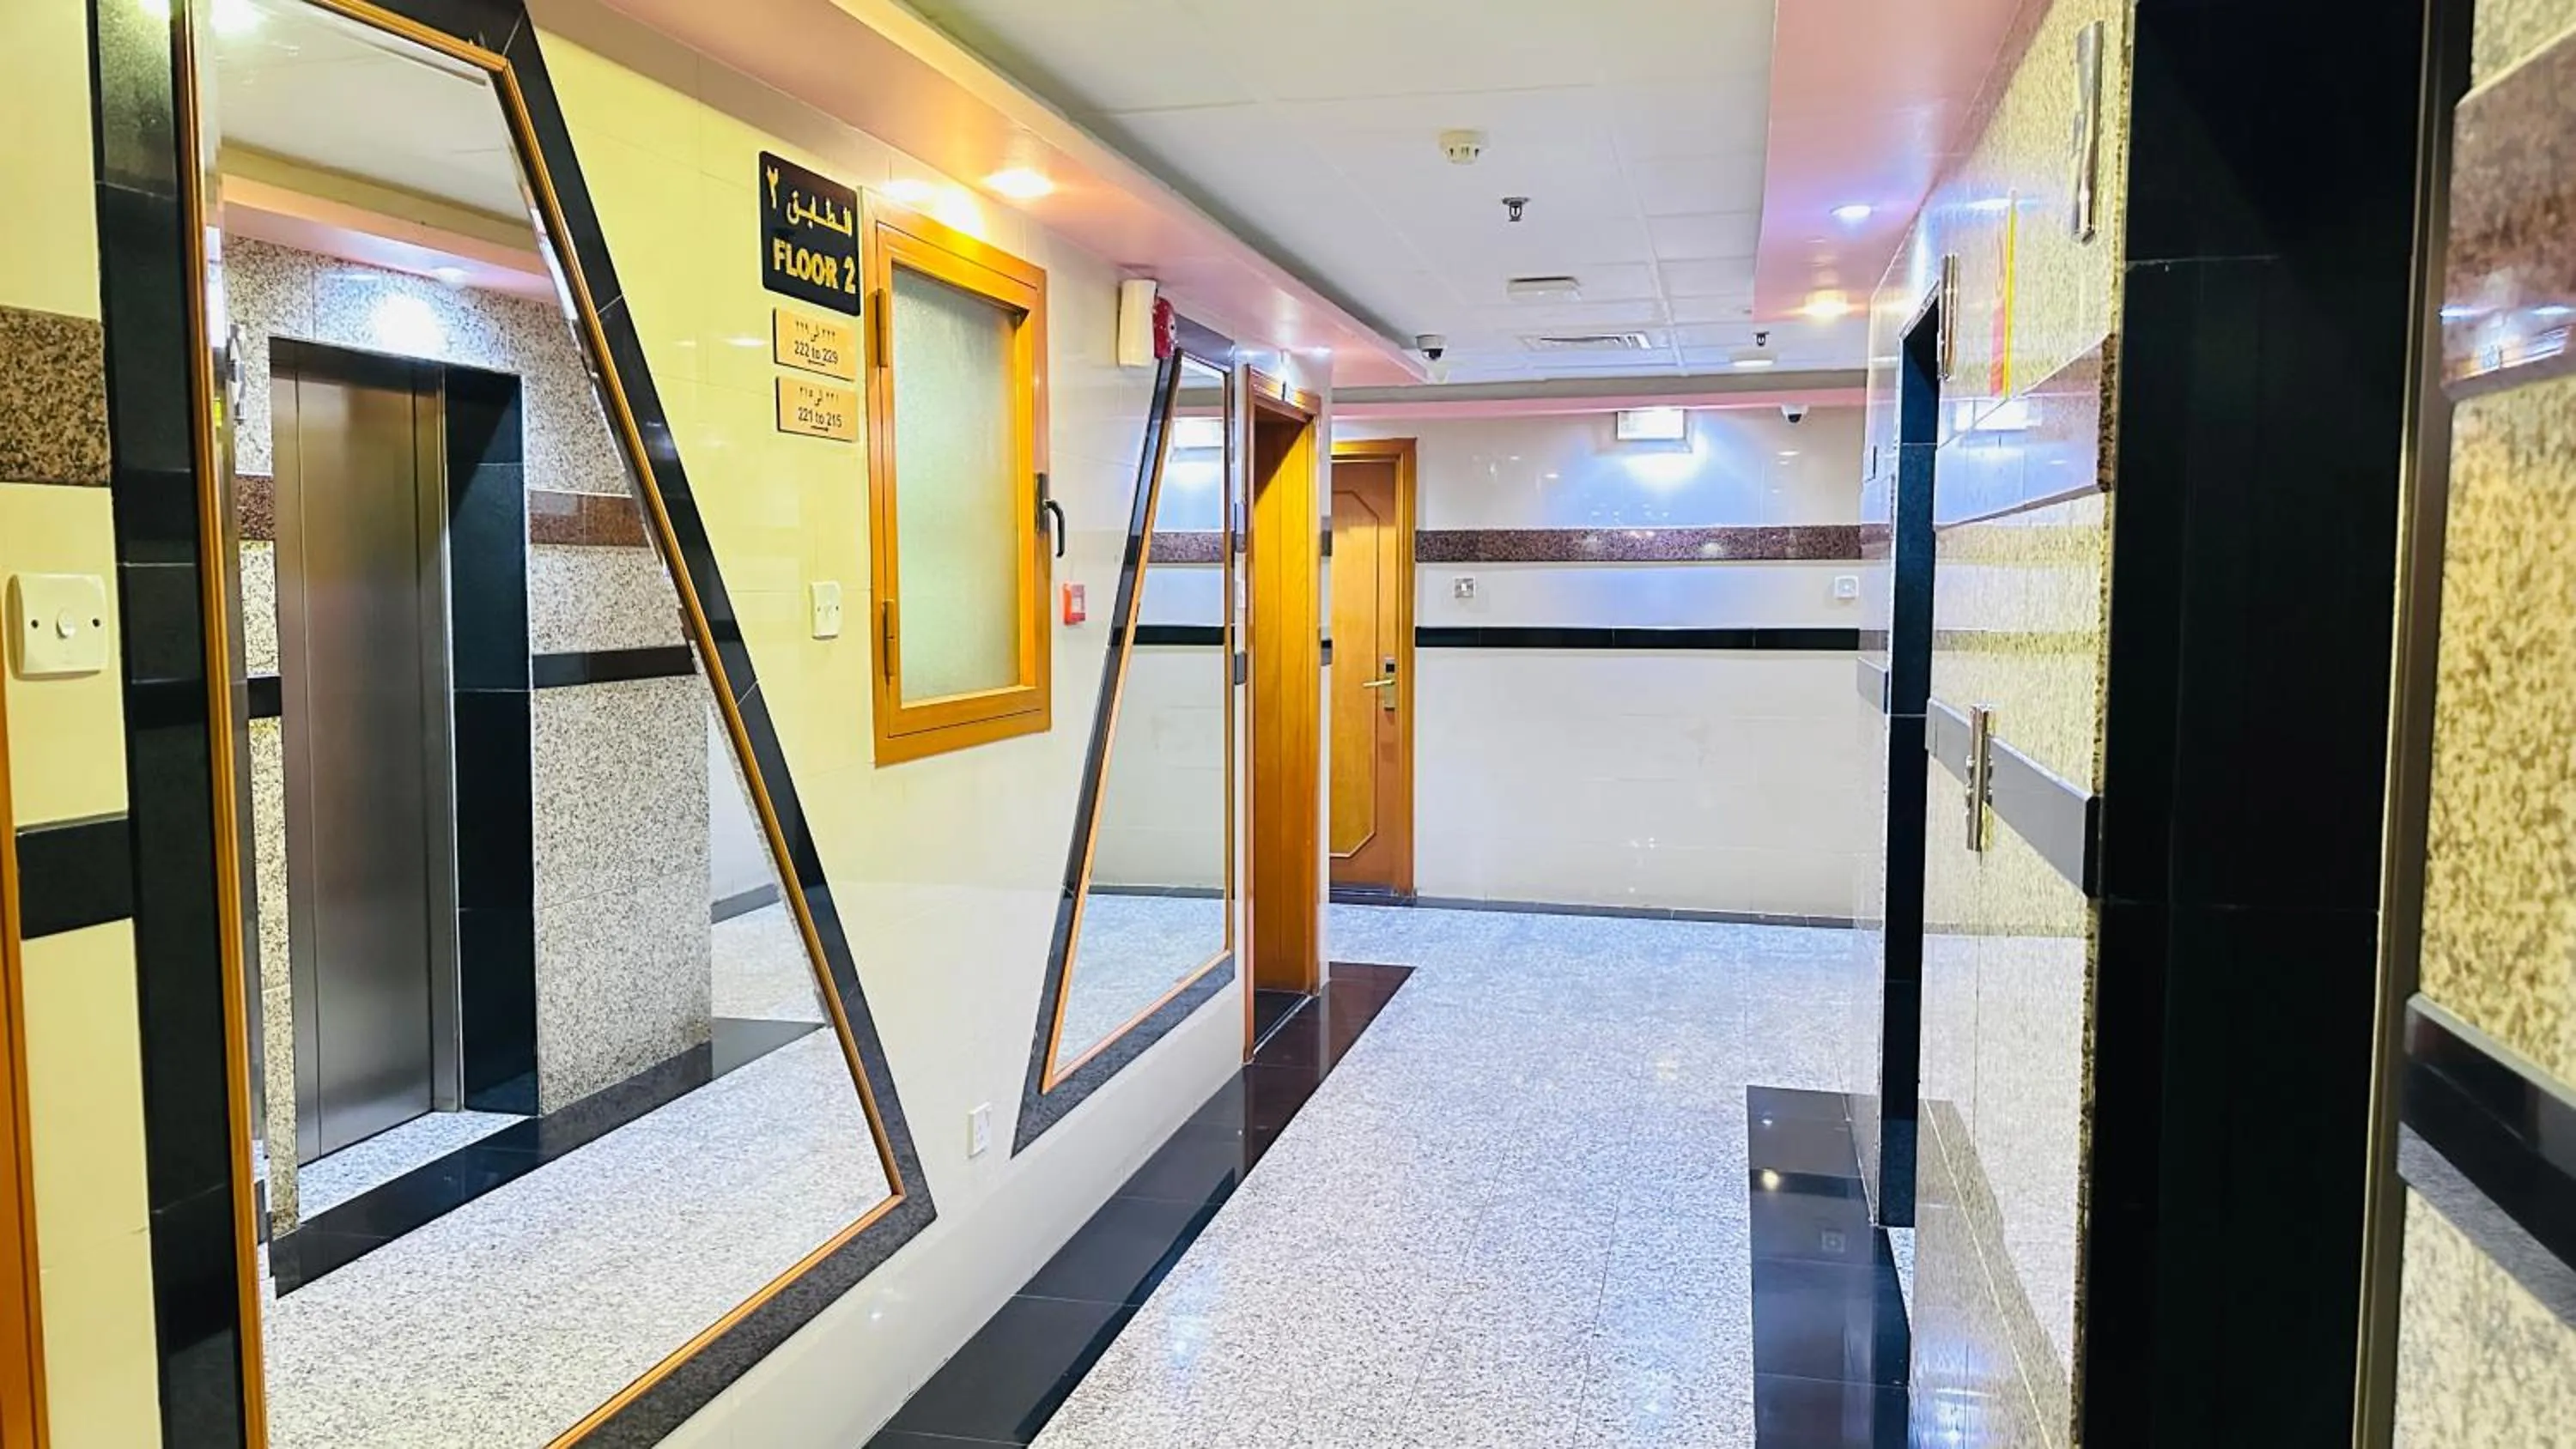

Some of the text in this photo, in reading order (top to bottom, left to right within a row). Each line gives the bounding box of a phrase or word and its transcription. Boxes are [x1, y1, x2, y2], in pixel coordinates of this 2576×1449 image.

[787, 191, 852, 237] الطابق
[774, 237, 856, 294] FLOOR 2
[794, 339, 839, 364] 222 to 229
[798, 406, 842, 428] 221 to 215
